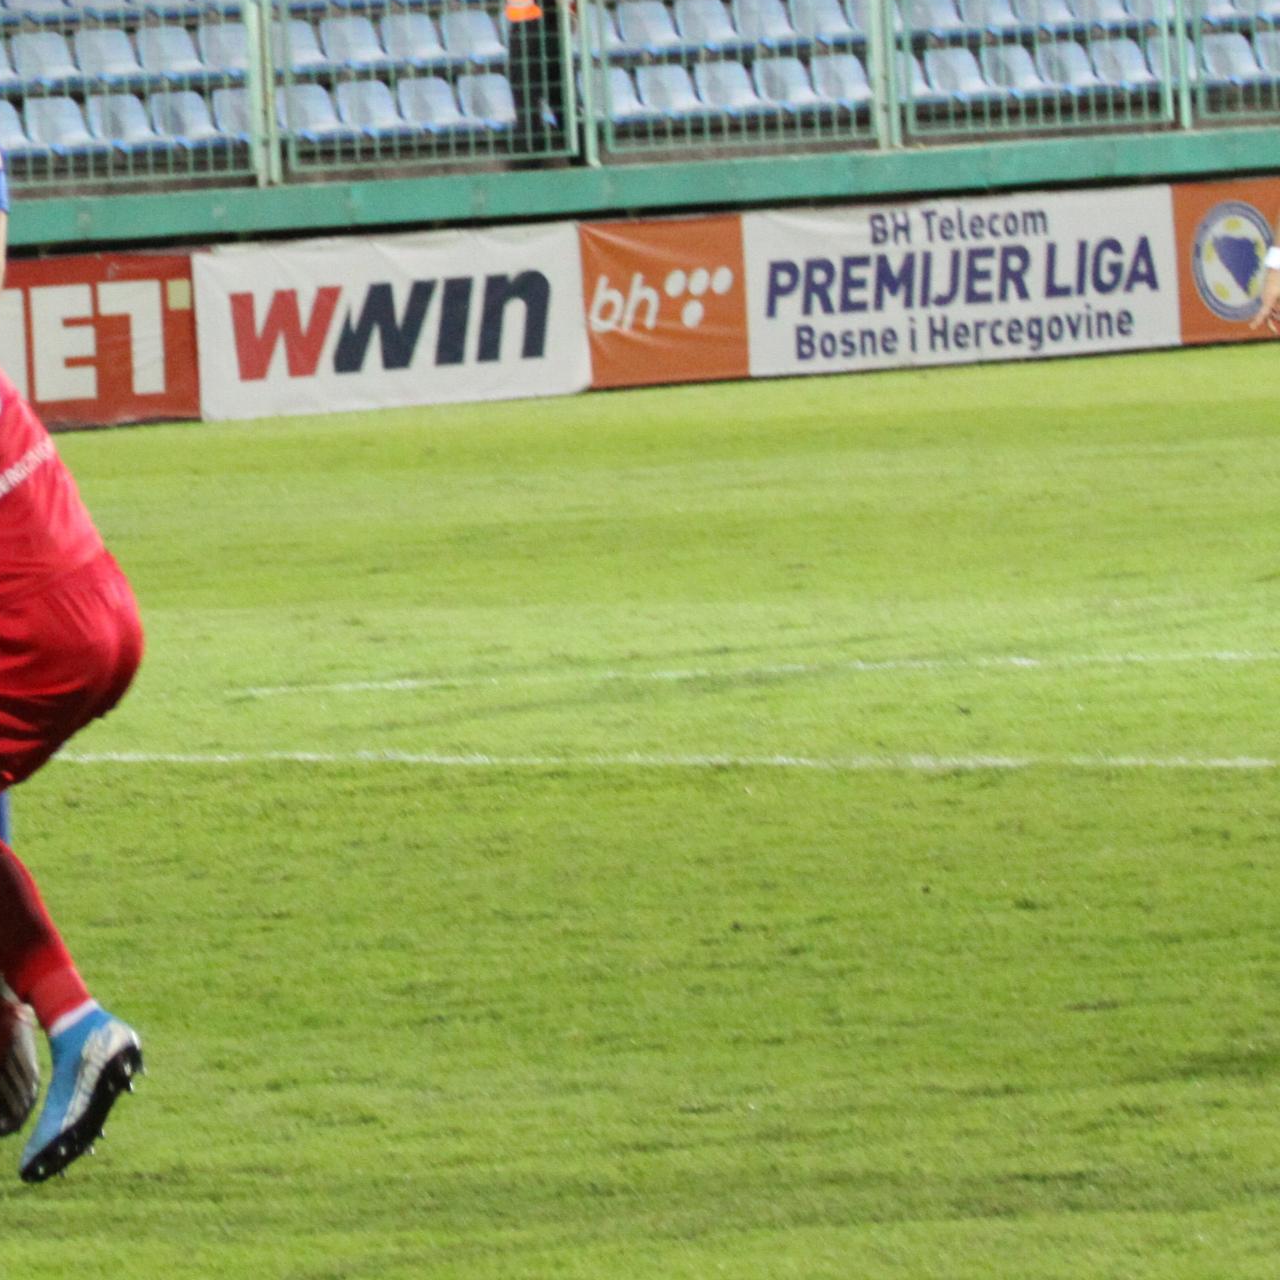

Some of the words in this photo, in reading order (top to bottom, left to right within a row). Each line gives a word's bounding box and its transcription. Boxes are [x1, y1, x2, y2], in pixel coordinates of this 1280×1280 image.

[870, 209, 911, 245] BH
[926, 208, 1048, 241] Telecom
[588, 271, 659, 332] bh
[766, 245, 1031, 317] PREMIJER
[1044, 236, 1159, 298] LIGA
[796, 325, 897, 360] Bosne
[908, 318, 917, 354] i
[927, 307, 1134, 351] Hercegovine
